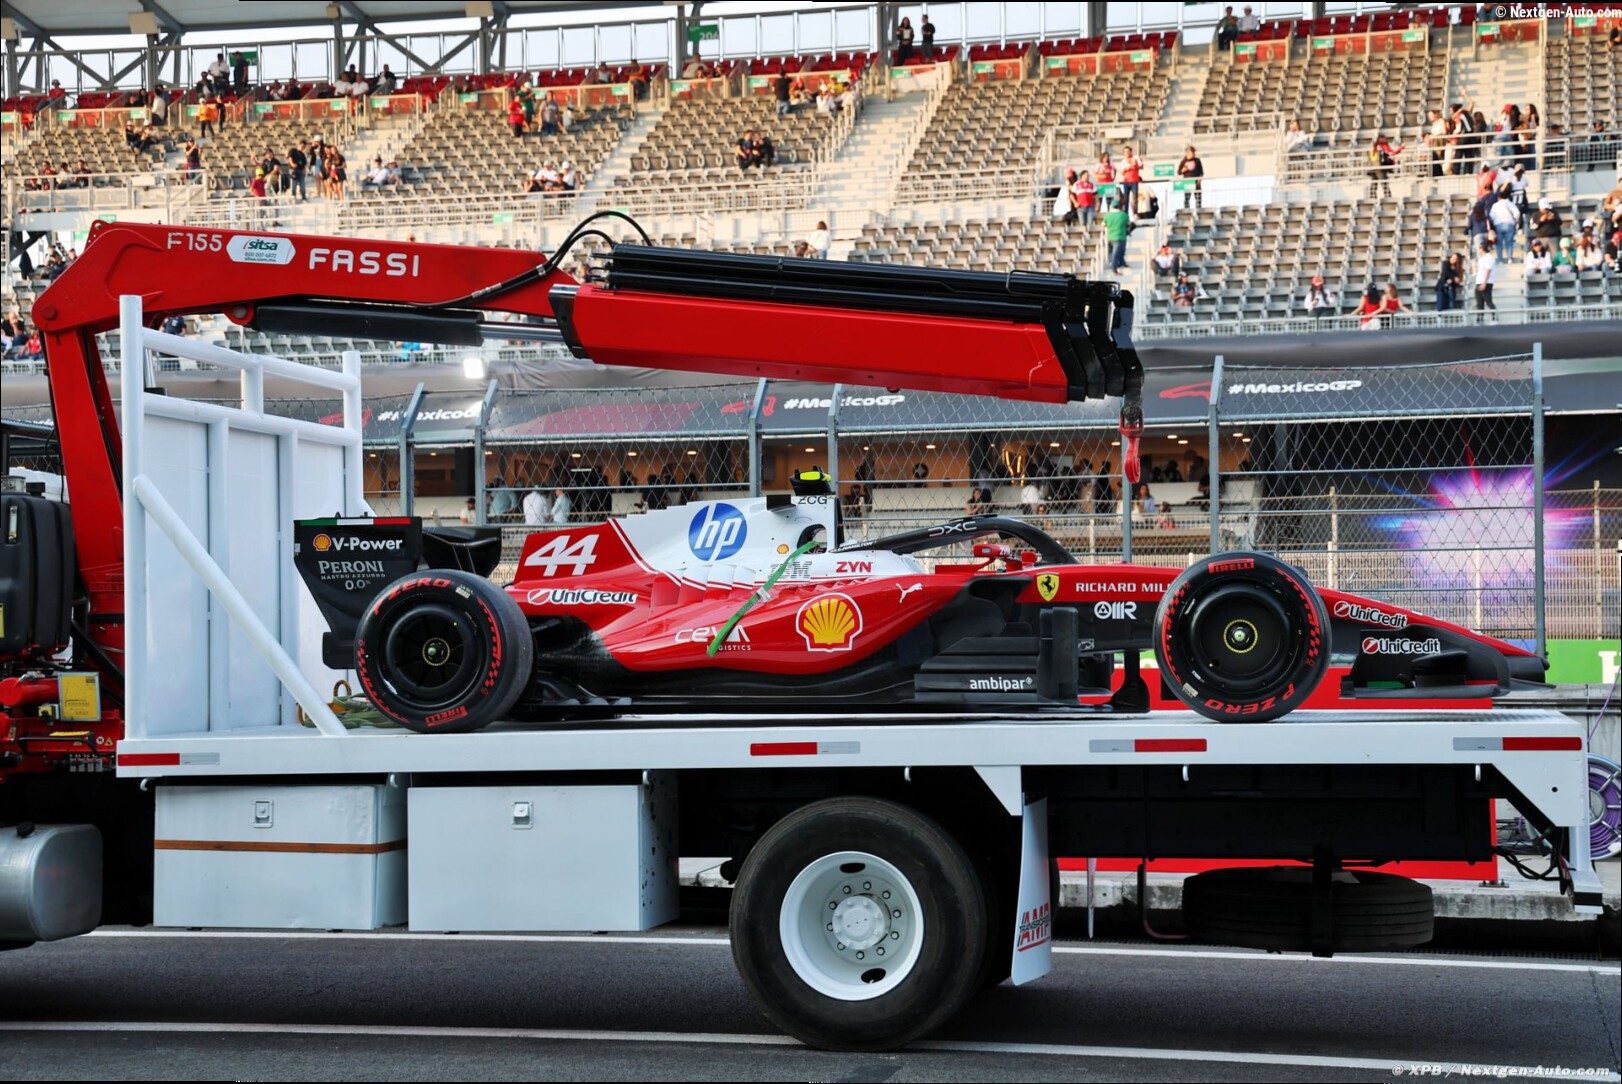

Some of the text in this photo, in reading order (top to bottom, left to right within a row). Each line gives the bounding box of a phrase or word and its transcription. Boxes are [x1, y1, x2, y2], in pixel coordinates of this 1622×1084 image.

[167, 232, 222, 252] F155
[247, 239, 278, 250] sitsa
[309, 247, 419, 277] FASSI
[1227, 380, 1362, 394] #MexicoGP
[783, 395, 906, 409] #MeicoGP
[694, 502, 743, 562] hp
[927, 520, 977, 537] DXC
[331, 537, 403, 551] V-Power
[524, 534, 600, 577] 44
[317, 560, 385, 575] PERONI
[836, 561, 872, 573] ZYN
[1208, 558, 1255, 574] PIRELLI
[388, 577, 451, 600] ZERO
[1075, 582, 1171, 592] RICHARD MIL
[551, 589, 638, 604] UniCredit
[1349, 605, 1407, 628] UniCredit
[1379, 639, 1440, 654] UniCredit
[969, 676, 1026, 692] ambipar
[1204, 695, 1277, 715] ZERO
[424, 705, 468, 727] PIRELLI
